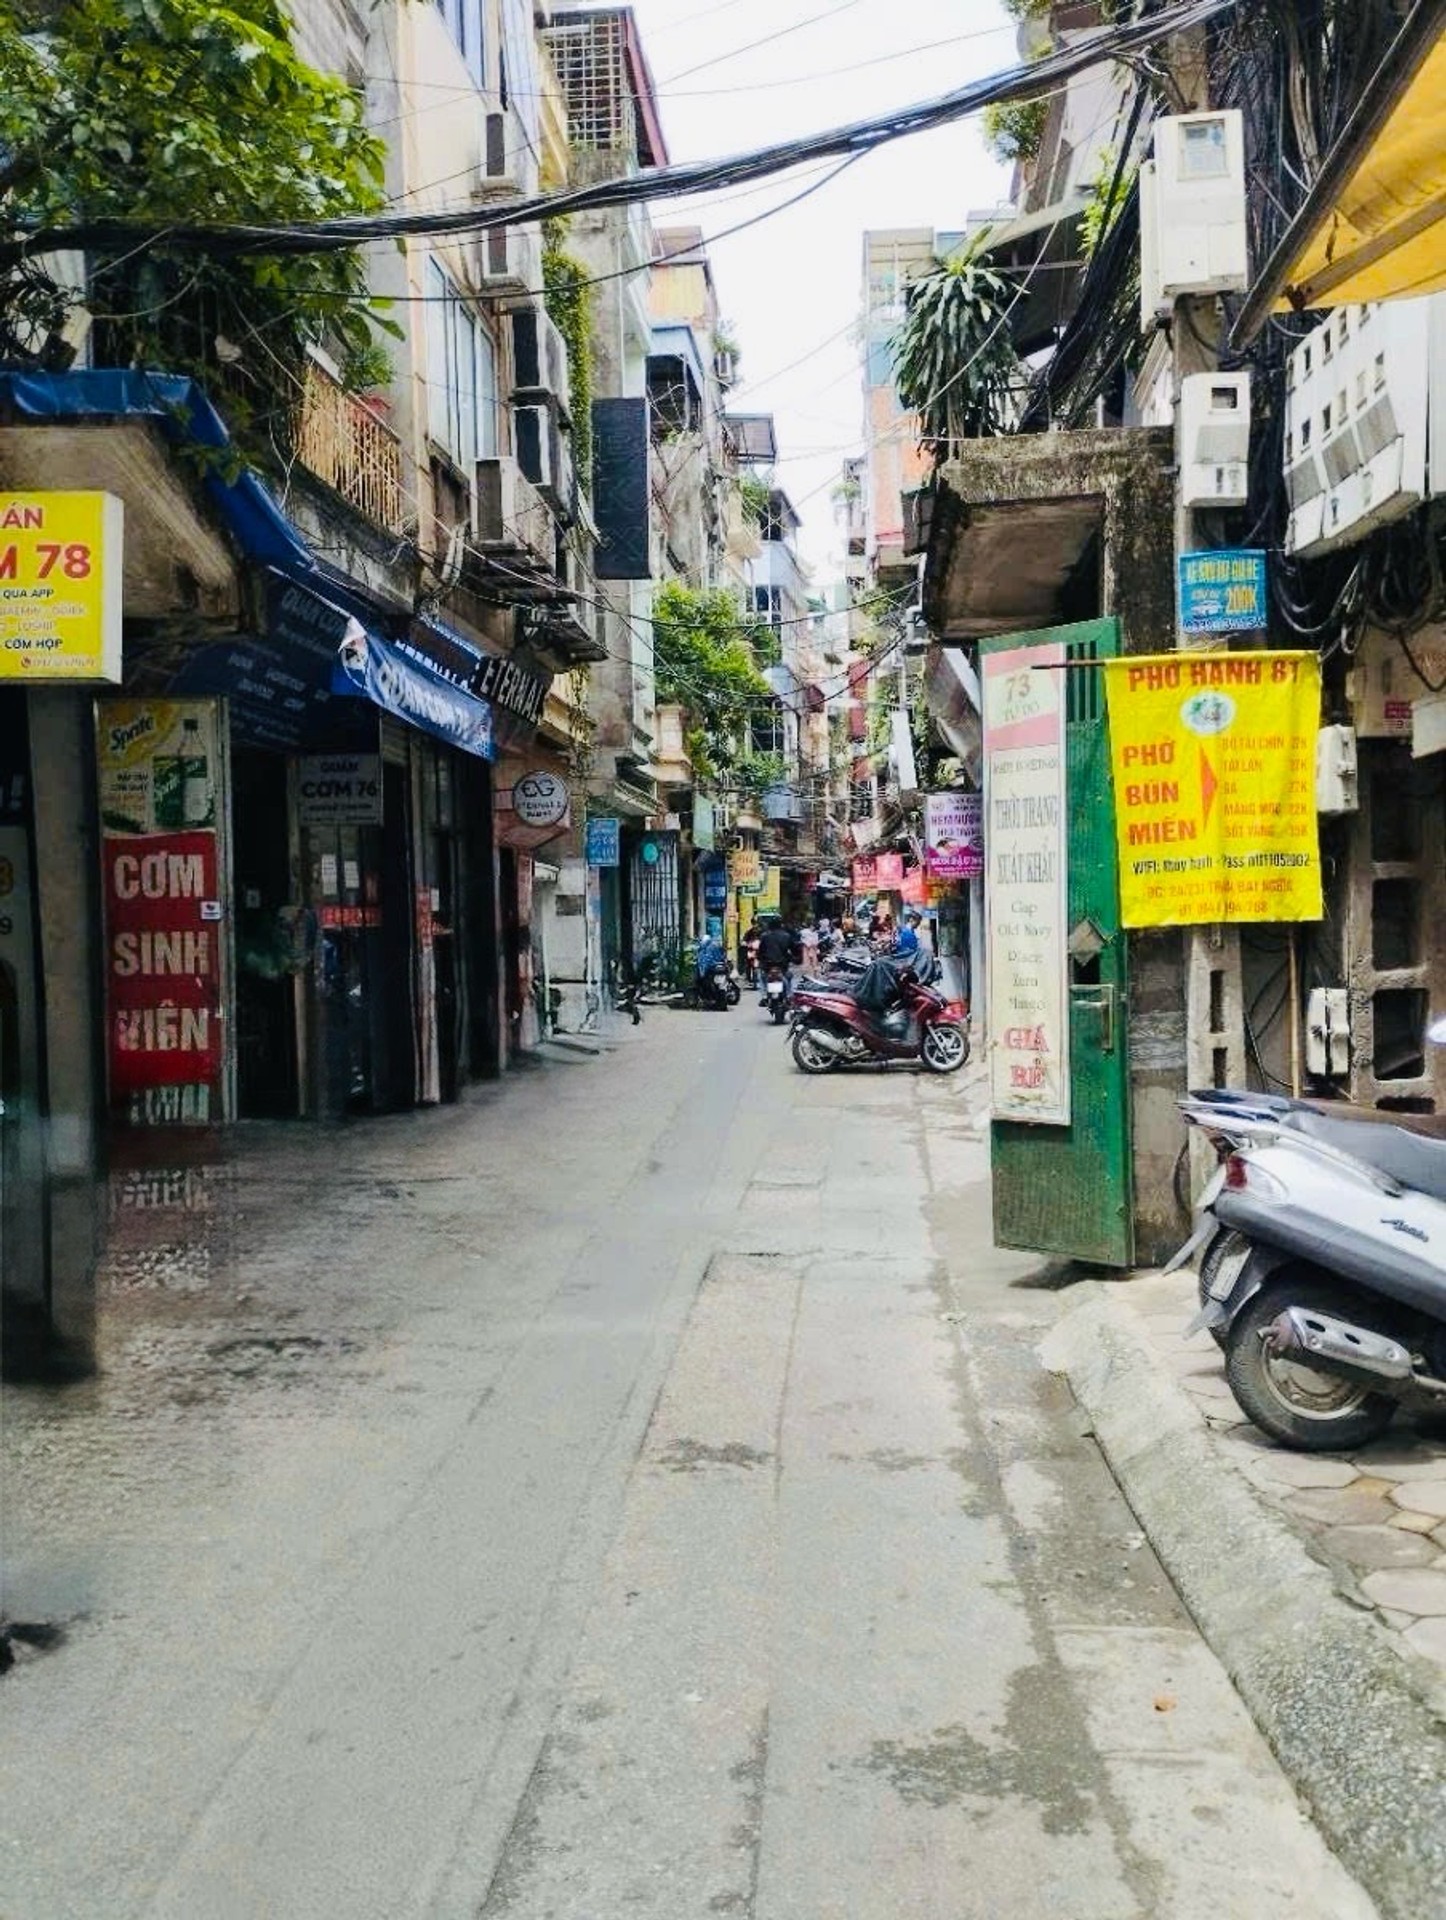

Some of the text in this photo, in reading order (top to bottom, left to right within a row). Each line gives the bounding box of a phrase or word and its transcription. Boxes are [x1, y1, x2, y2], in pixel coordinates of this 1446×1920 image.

[36, 544, 91, 579] 78
[3, 588, 54, 599] QUA APP
[5, 638, 31, 650] CƠM
[1005, 673, 1031, 702] 73
[110, 716, 154, 752] Sprite
[1122, 735, 1175, 769] PHỞ
[302, 780, 378, 799] CƠM 76
[1127, 811, 1197, 847] MIẾN
[113, 850, 205, 899] CƠM
[1010, 901, 1037, 918] Gap
[997, 924, 1019, 938] Old
[113, 931, 210, 977] SINH
[117, 999, 210, 1051] VIÊN
[1003, 1022, 1049, 1053] GIÁ
